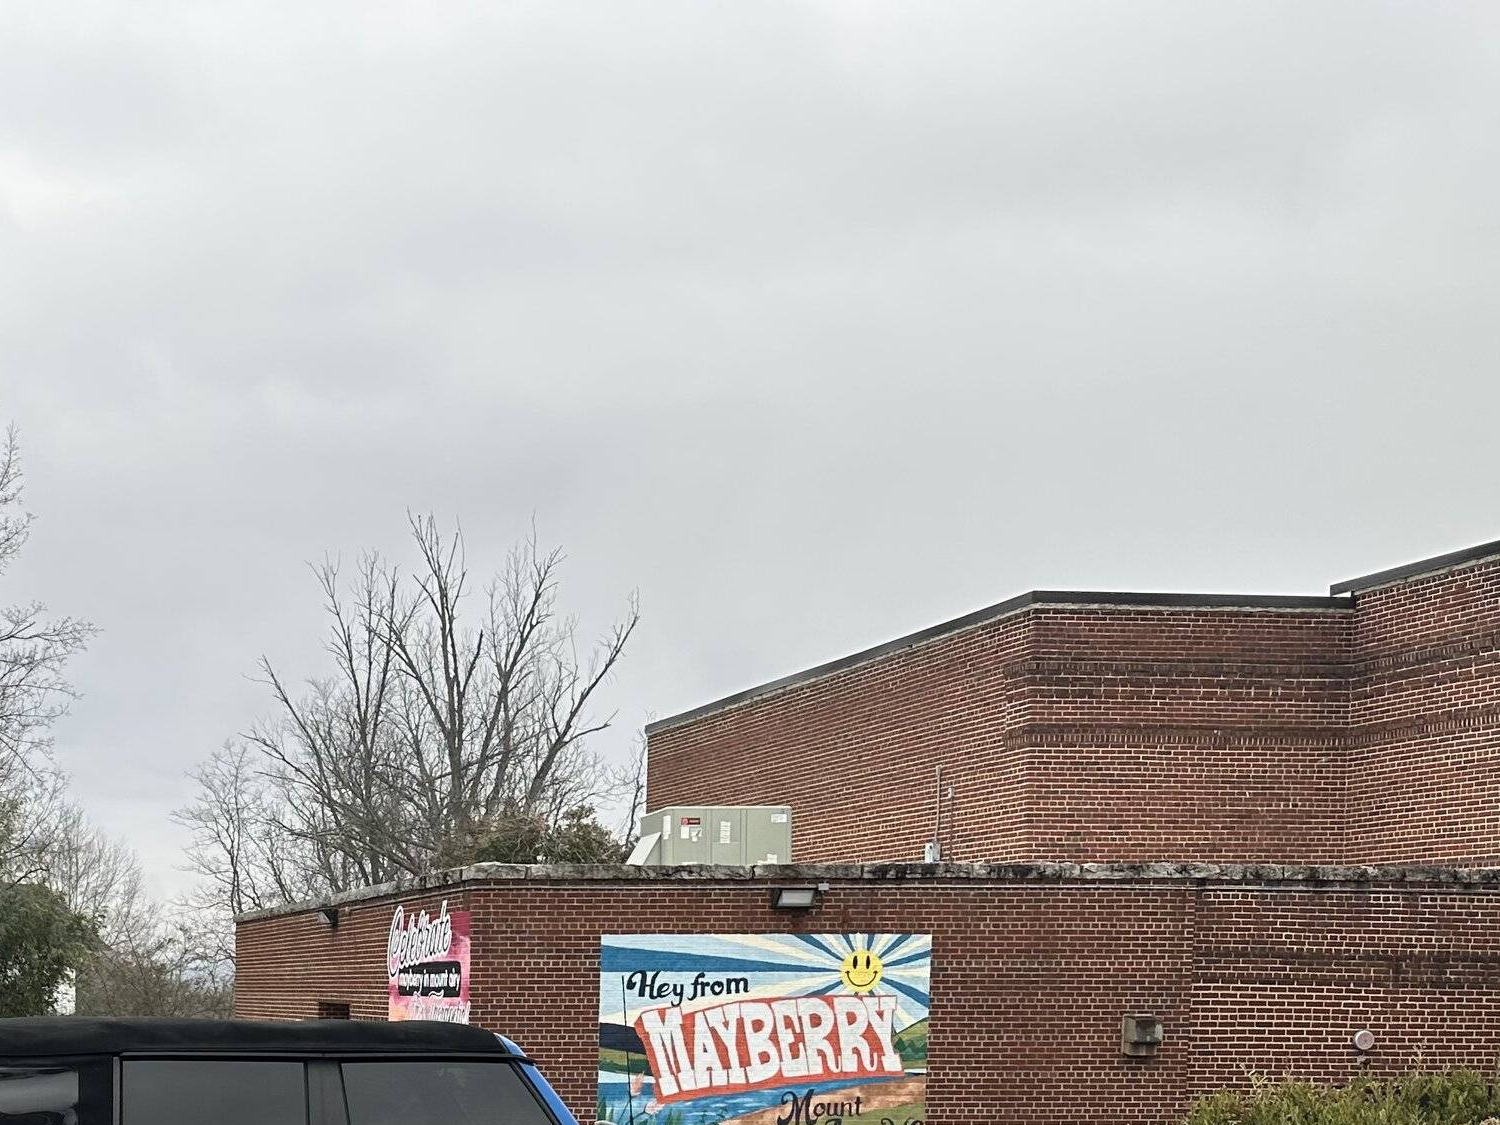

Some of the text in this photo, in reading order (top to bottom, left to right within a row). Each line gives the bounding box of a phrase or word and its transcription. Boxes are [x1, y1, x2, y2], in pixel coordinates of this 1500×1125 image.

[387, 900, 452, 977] Celebrate
[626, 970, 750, 1007] Hey from
[641, 995, 902, 1097] MAYBERRY
